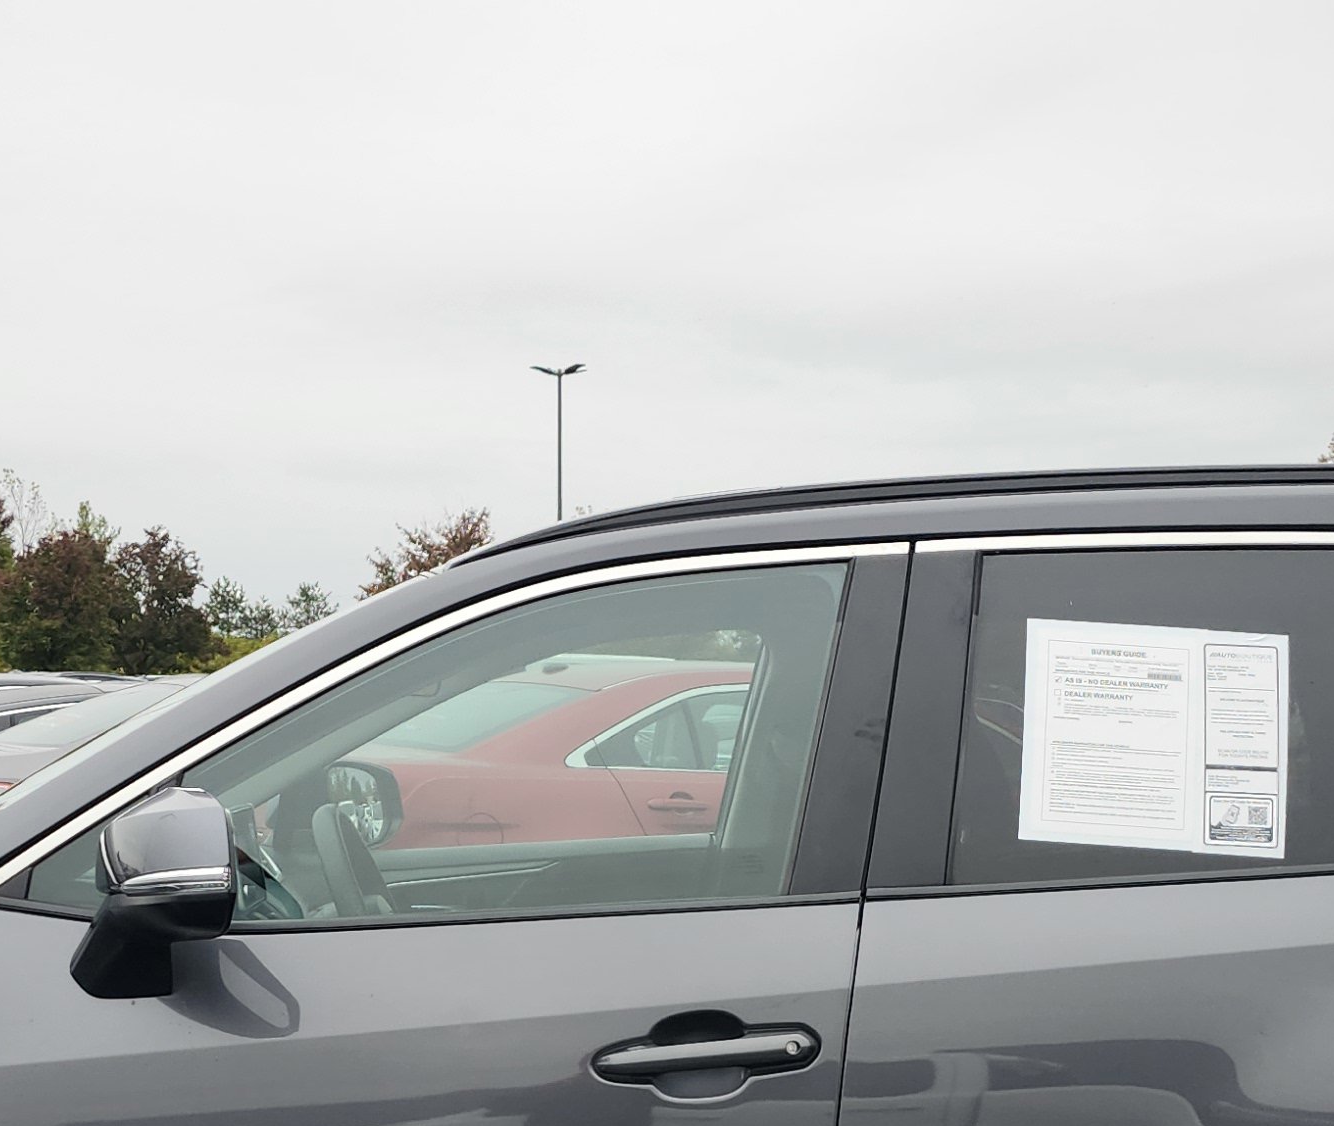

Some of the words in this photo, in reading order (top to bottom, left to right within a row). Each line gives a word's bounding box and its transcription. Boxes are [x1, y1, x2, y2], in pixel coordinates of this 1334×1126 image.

[1123, 651, 1147, 659] GUIDE
[1100, 679, 1127, 687] DEALER
[1129, 681, 1168, 689] WARRANTY
[1064, 690, 1092, 698] DEALER
[1094, 692, 1133, 700] WARRANTY
